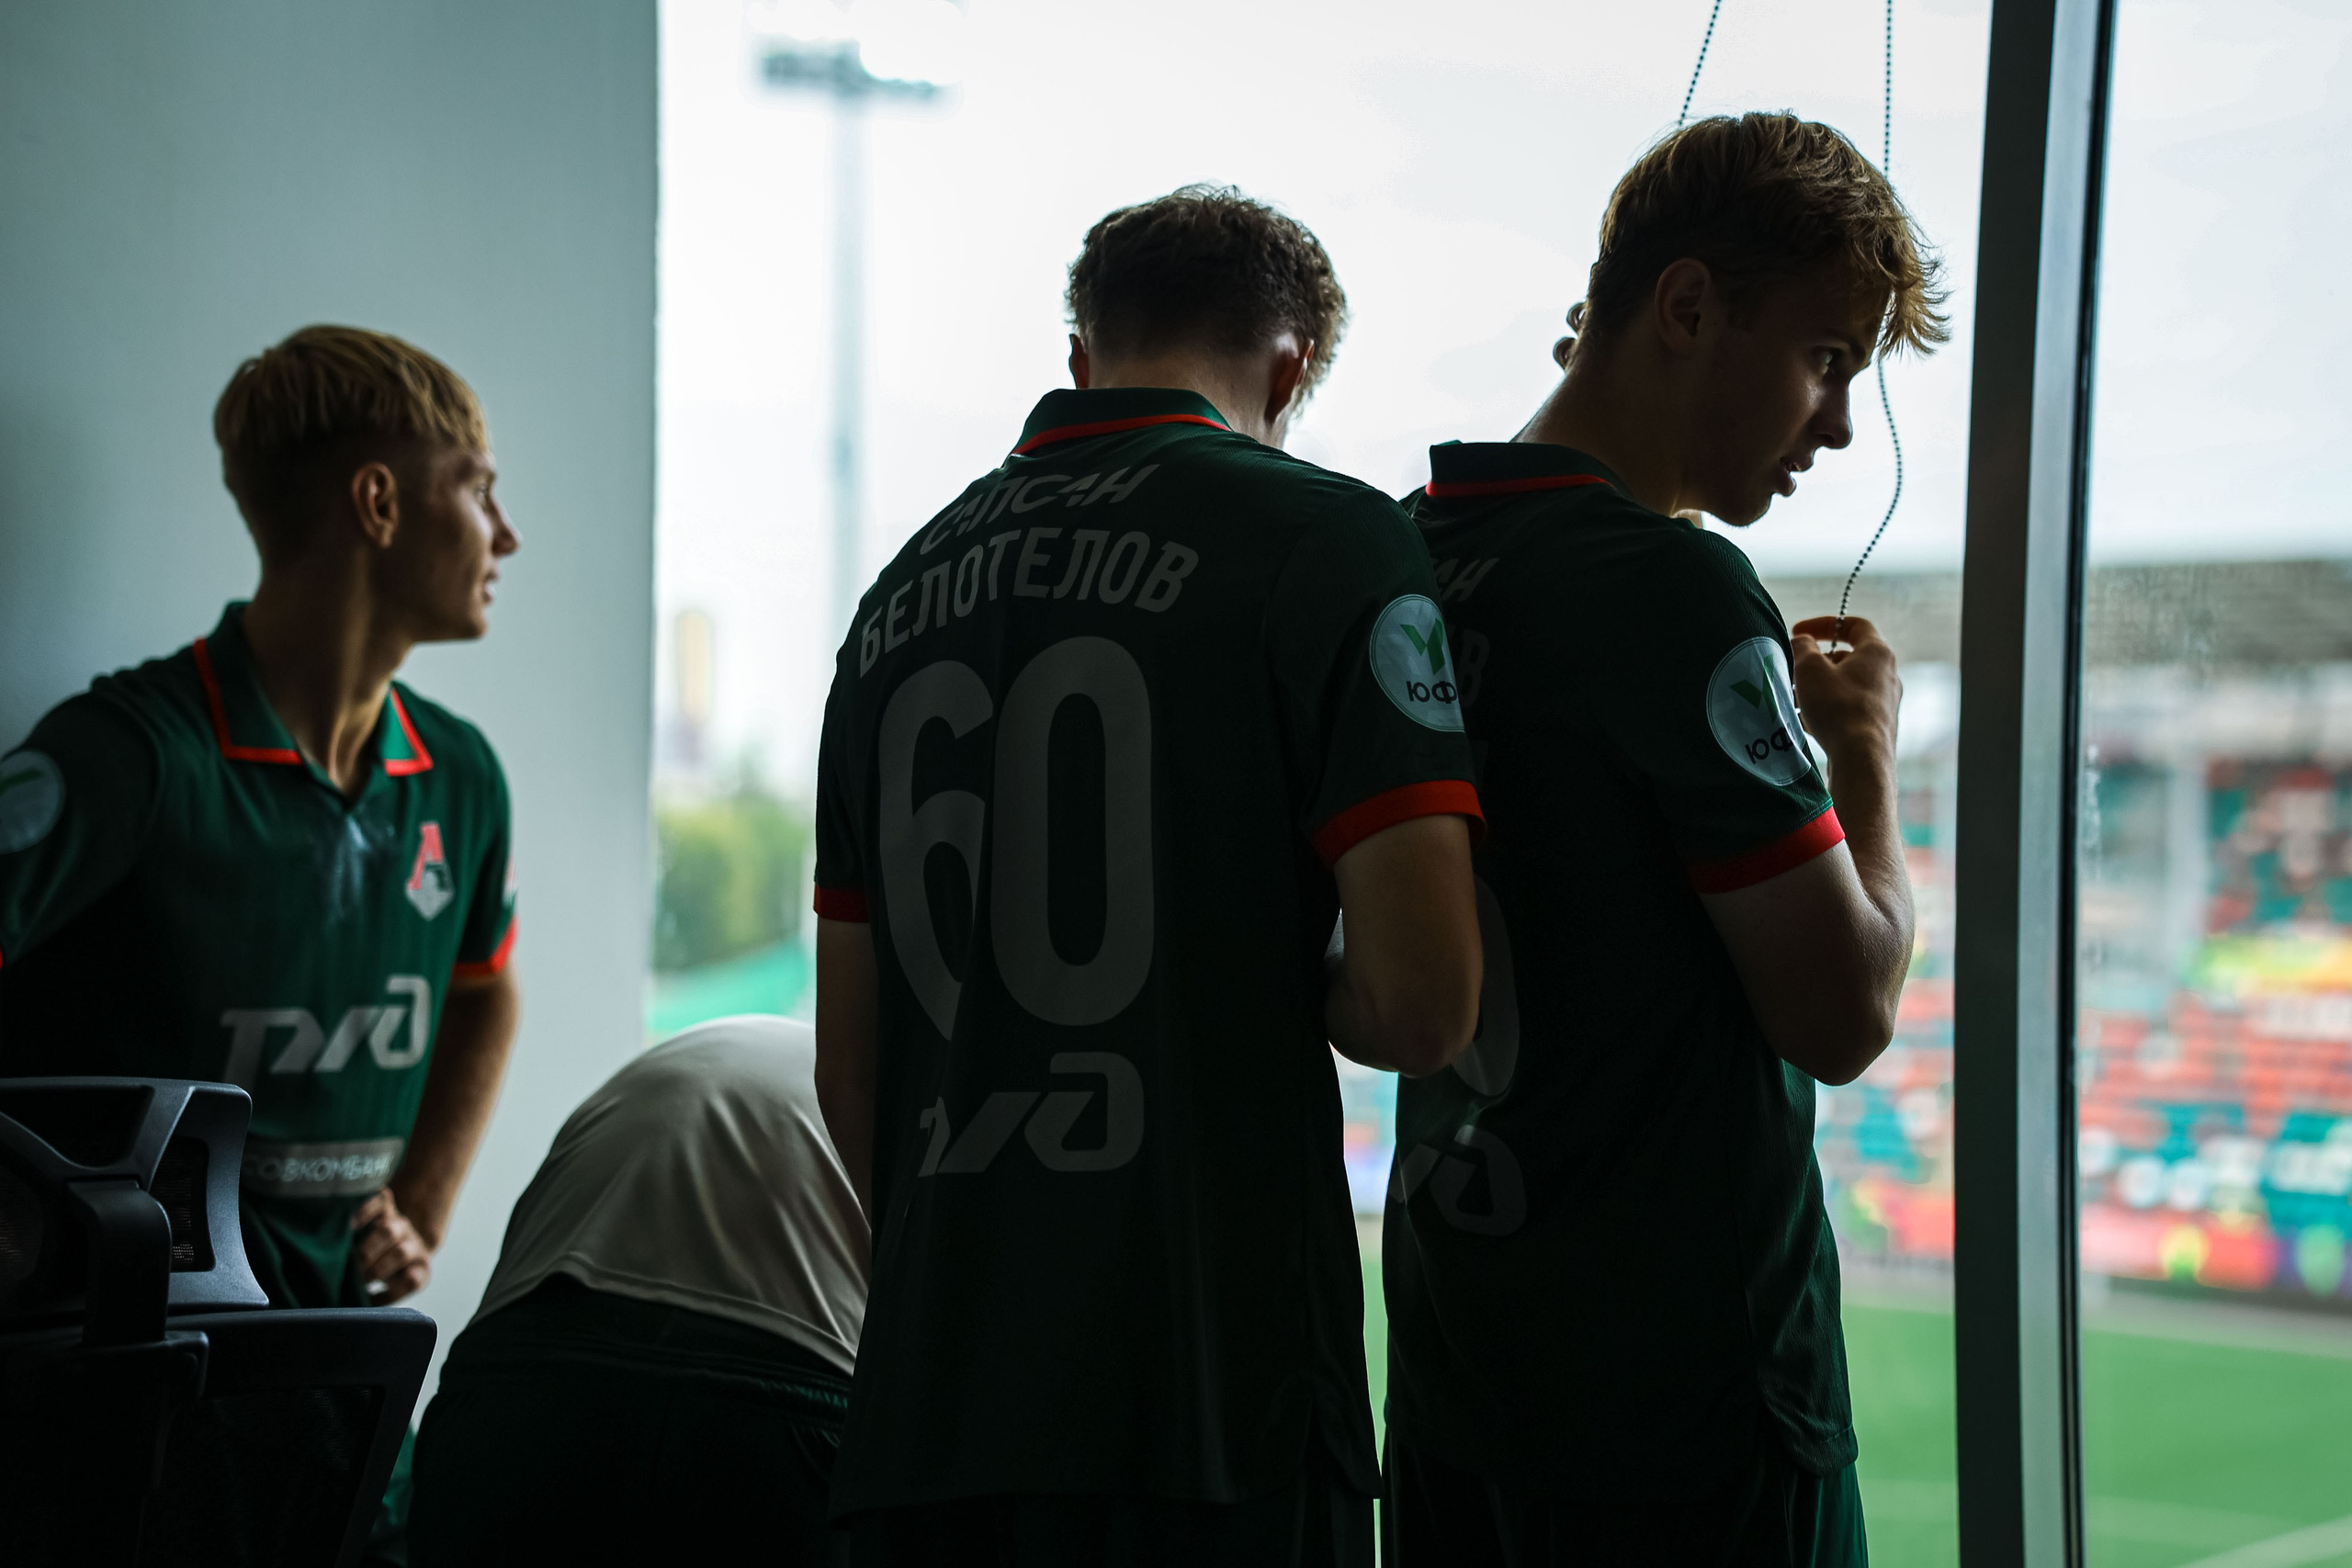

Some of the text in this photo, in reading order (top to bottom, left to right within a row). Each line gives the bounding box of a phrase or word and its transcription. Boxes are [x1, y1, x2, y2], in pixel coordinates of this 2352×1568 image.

[920, 464, 1160, 556] САПСАН
[860, 526, 1200, 679] БЕЛОТЕЛОВ
[1406, 681, 1459, 705] ЮФ
[1745, 726, 1793, 764] ЮФ
[878, 635, 1156, 1042] 60
